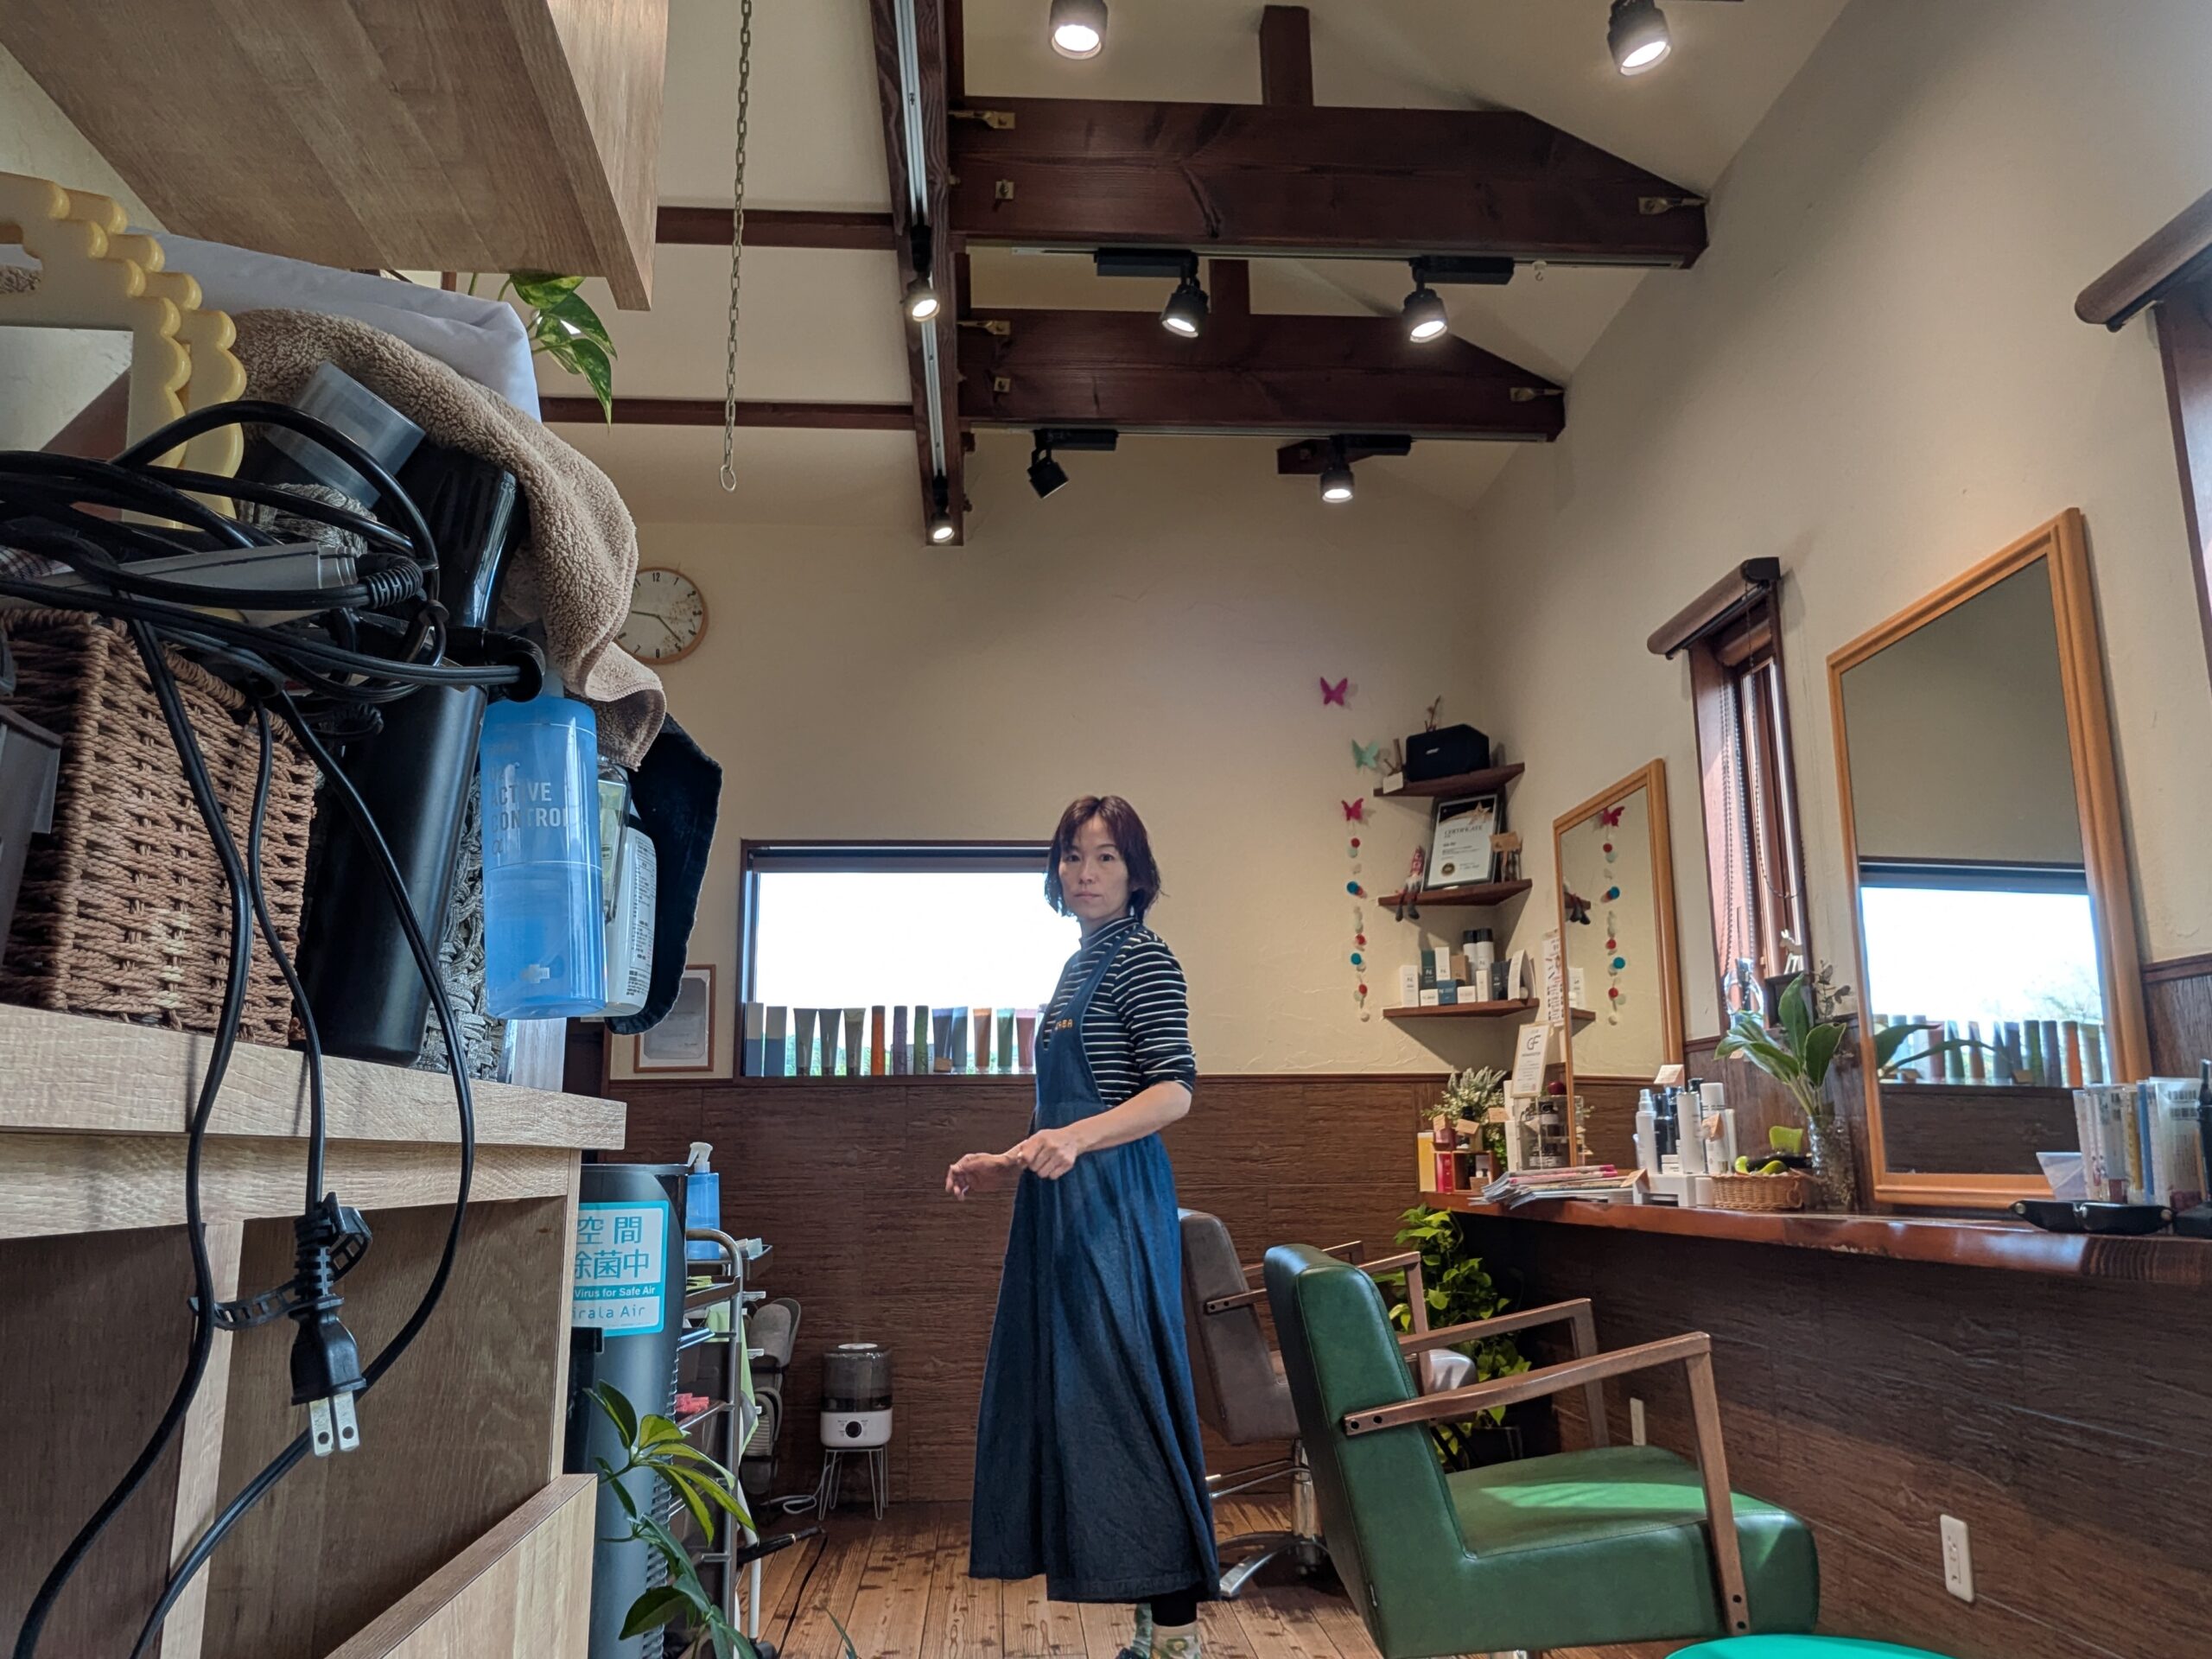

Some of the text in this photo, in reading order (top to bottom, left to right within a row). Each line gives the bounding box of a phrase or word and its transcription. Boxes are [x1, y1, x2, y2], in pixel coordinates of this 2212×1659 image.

[652, 572, 660, 582] 12
[577, 1215, 643, 1245] 空間
[602, 1287, 617, 1298] for
[619, 1286, 641, 1296] Safe
[642, 1285, 656, 1295] Air
[572, 1304, 646, 1320] irala Air
